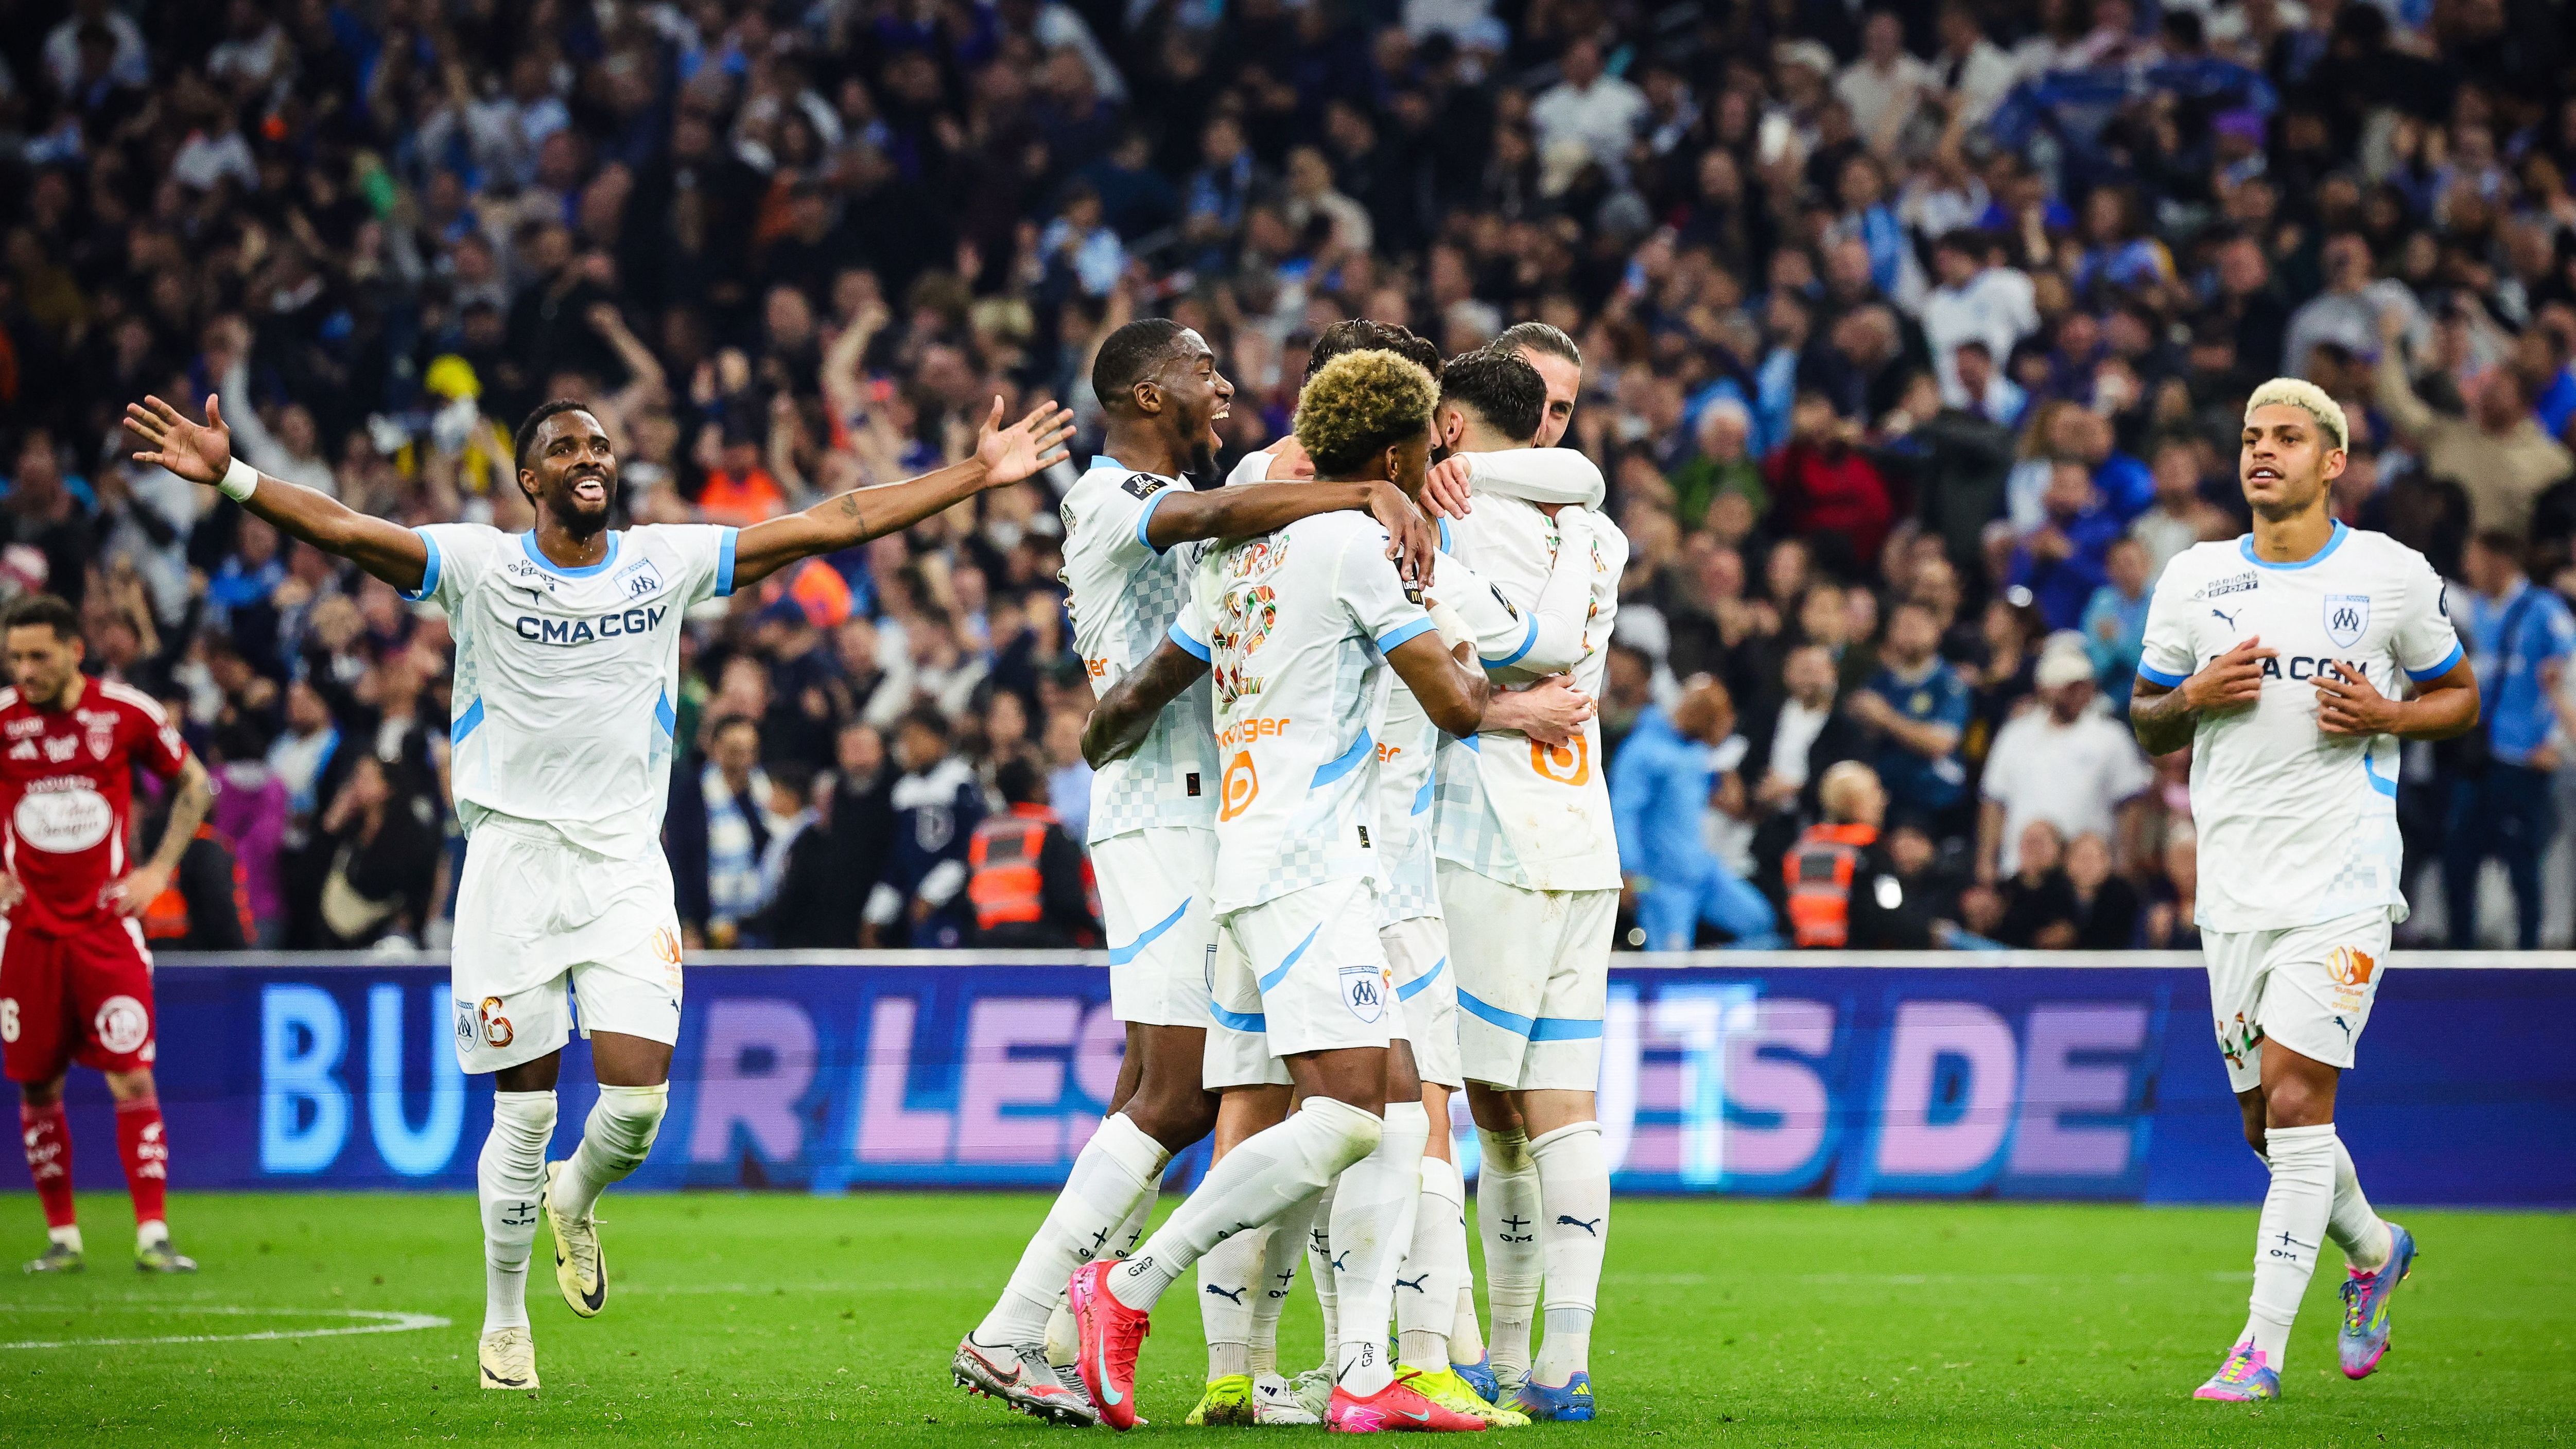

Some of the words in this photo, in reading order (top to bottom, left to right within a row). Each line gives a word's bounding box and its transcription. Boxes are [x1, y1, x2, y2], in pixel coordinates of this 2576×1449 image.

[1134, 479, 1155, 495] LIGUE
[1403, 580, 1419, 590] LIGU
[2207, 569, 2257, 588] PARIONS
[2208, 580, 2258, 598] SPORT
[516, 617, 595, 643] CMA
[600, 605, 668, 637] CGM
[479, 996, 514, 1049] 6
[1874, 1000, 2149, 1178] DE
[1499, 1233, 1534, 1244] OM
[2270, 1249, 2297, 1261] OM
[1128, 1256, 1153, 1277] GRIP
[1362, 1342, 1374, 1367] GRIP
